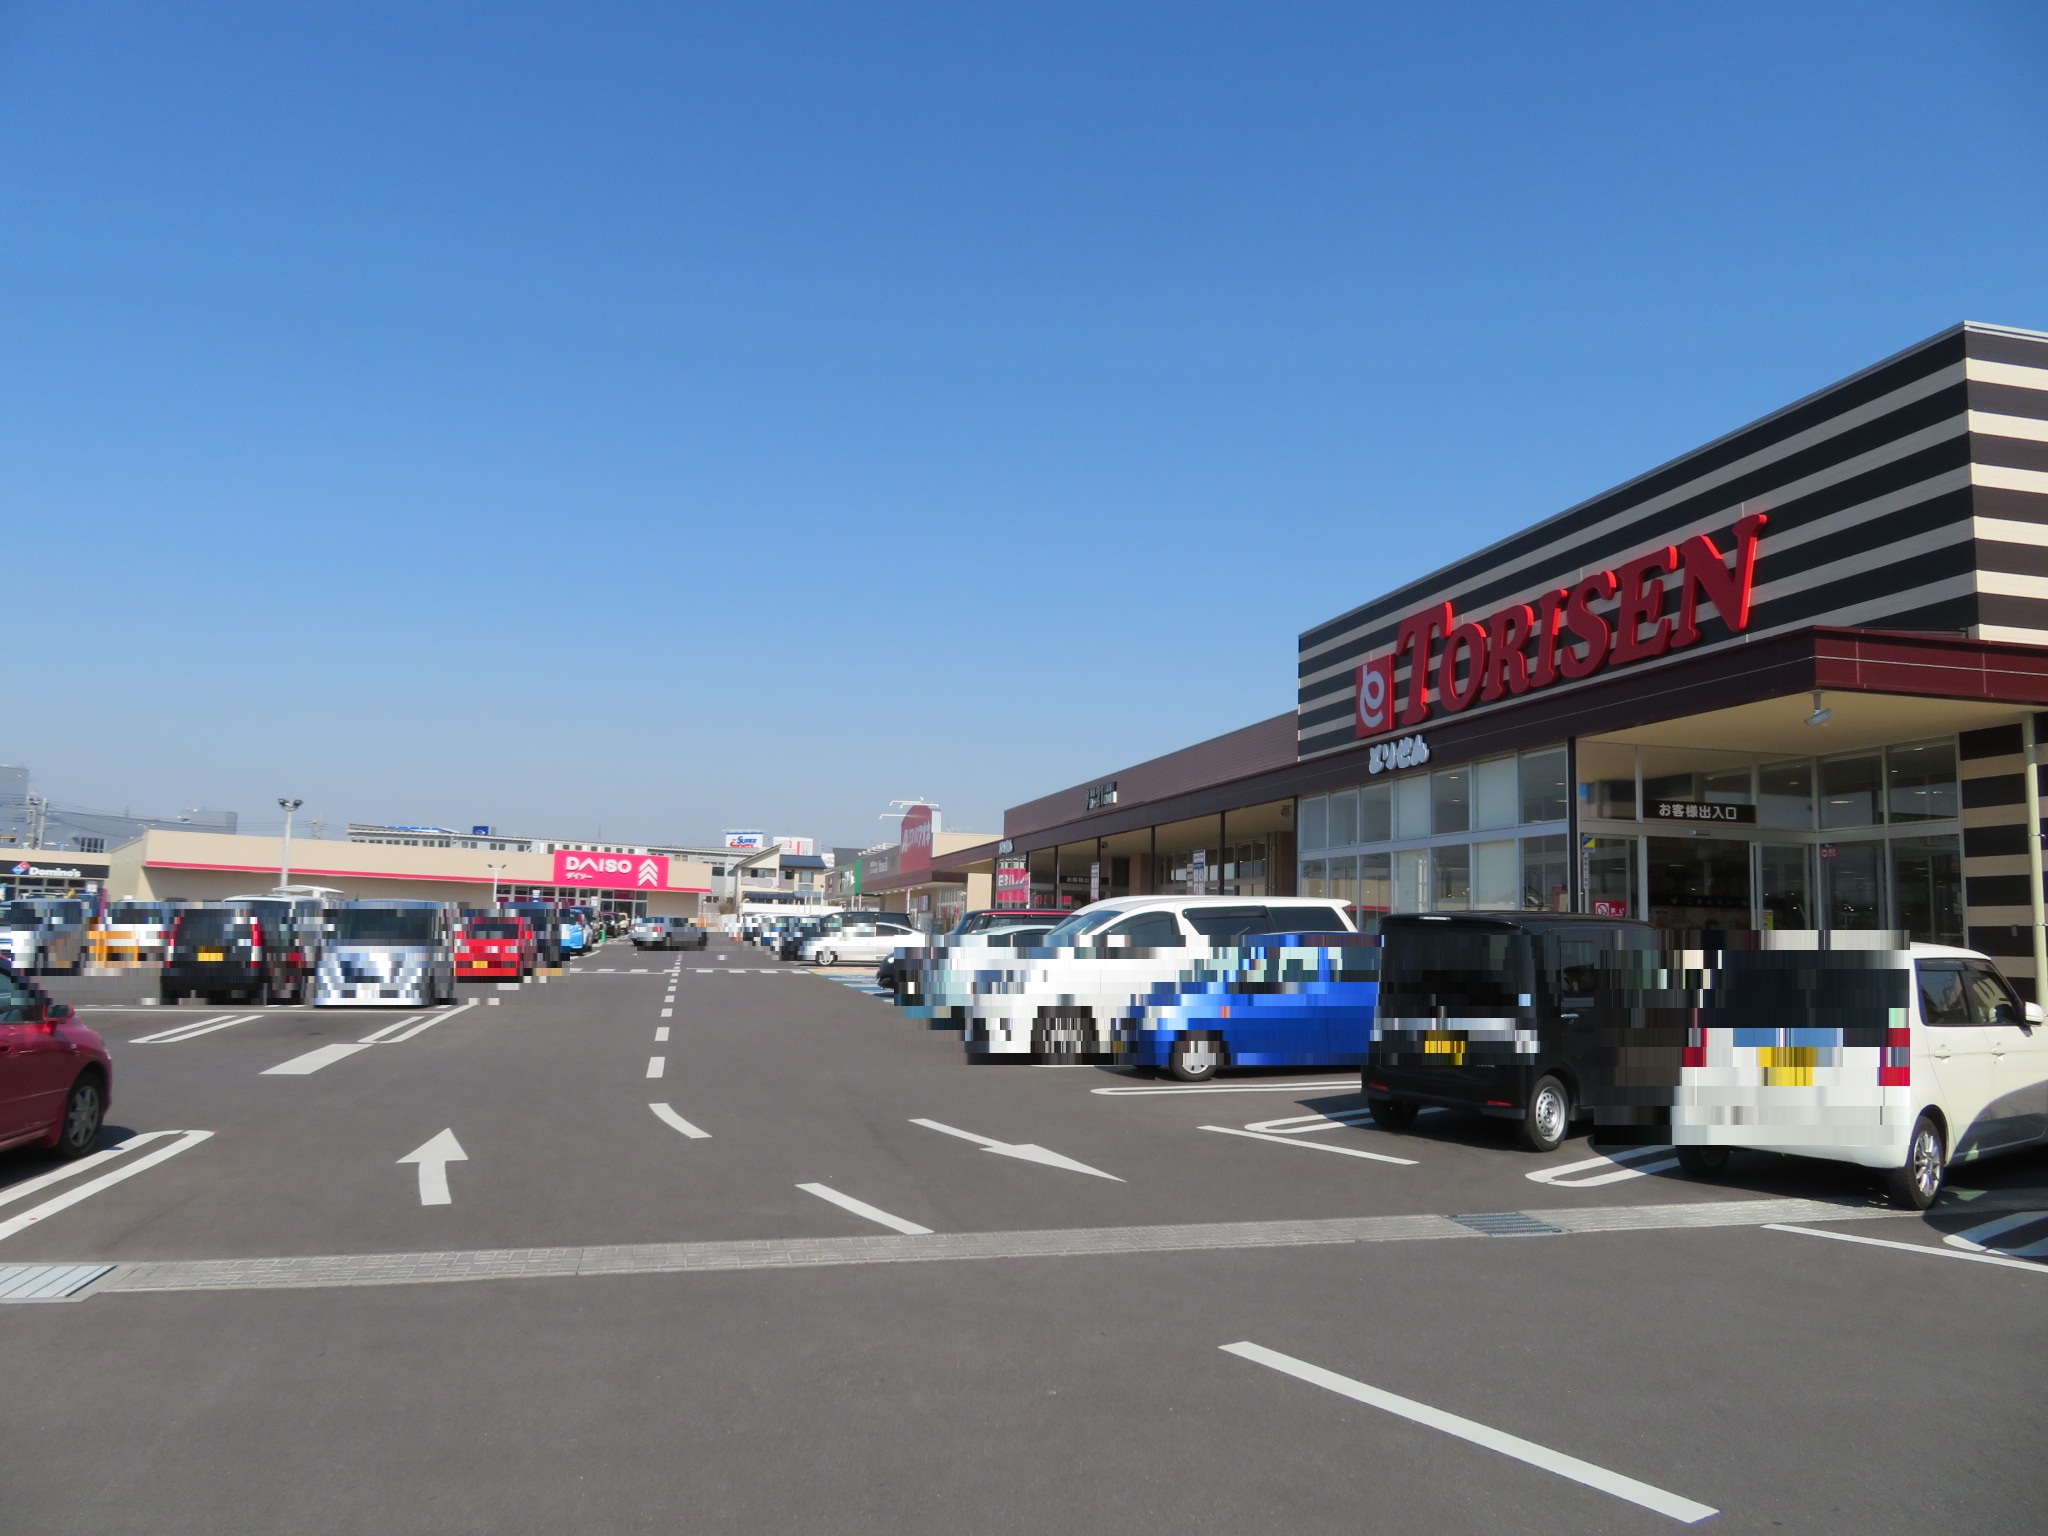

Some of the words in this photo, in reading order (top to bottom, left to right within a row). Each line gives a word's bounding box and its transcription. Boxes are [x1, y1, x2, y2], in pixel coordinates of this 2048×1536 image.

[1396, 514, 1768, 725] TORISEN
[1369, 734, 1430, 774] とりせん
[1659, 803, 1737, 820] お客様出入口
[29, 867, 81, 877] Domino's
[566, 856, 632, 874] DAISO
